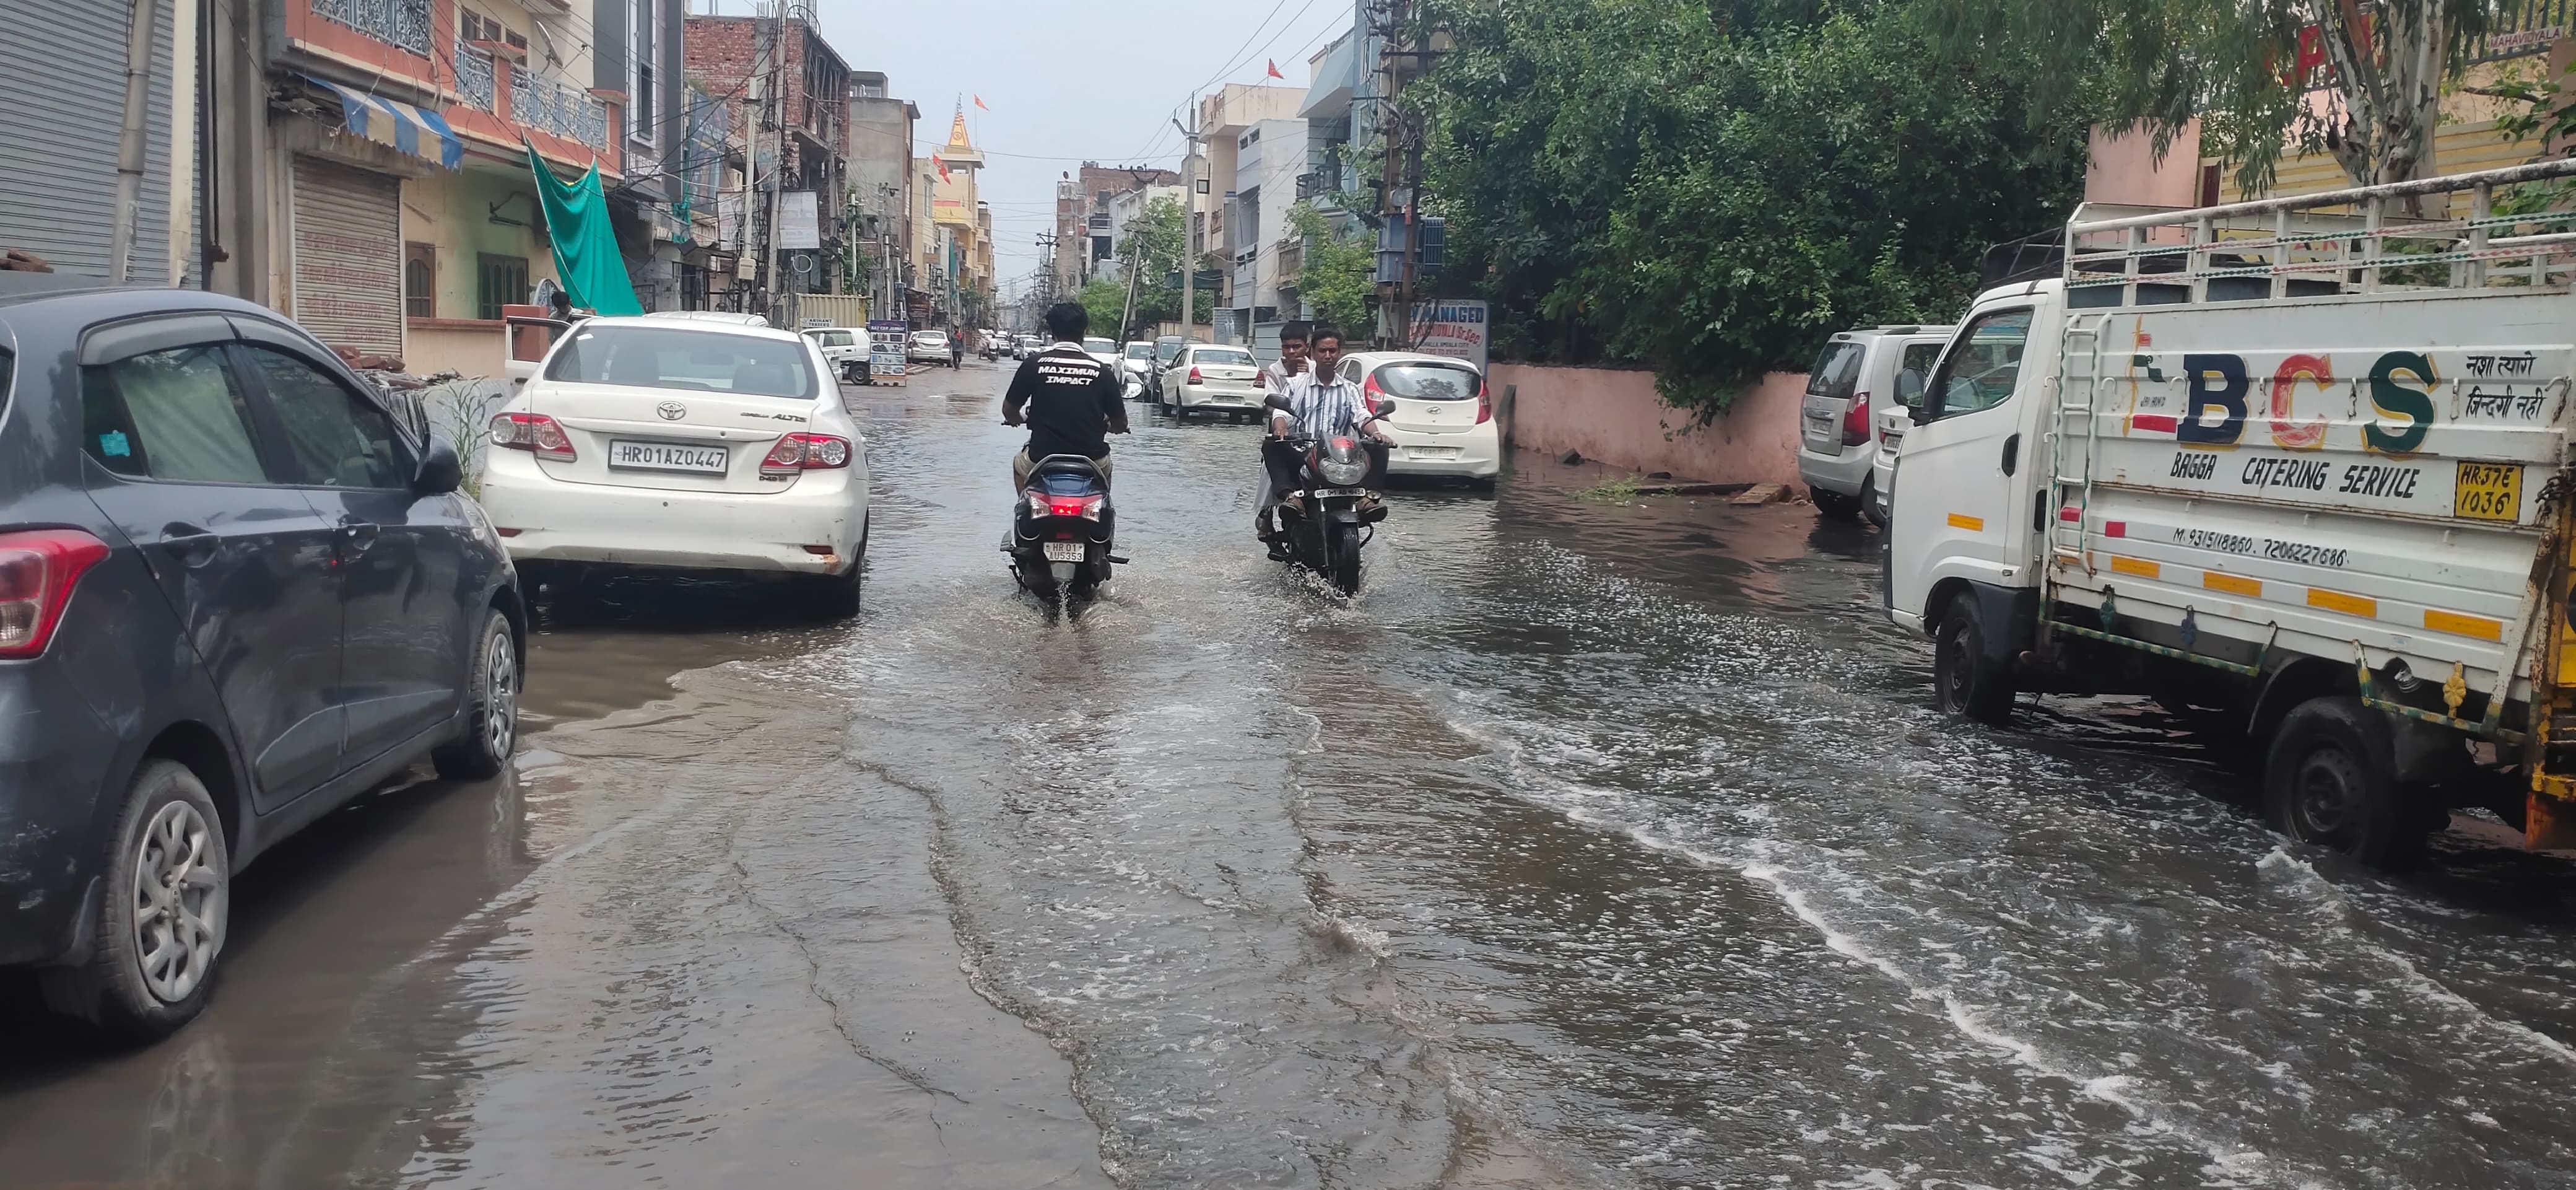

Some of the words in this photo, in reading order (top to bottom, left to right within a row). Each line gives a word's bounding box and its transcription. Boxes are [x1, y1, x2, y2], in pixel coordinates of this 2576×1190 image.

[2491, 27, 2560, 48] MAHAVIDYALA
[1038, 366, 1100, 378] MAXIMUM
[2466, 356, 2495, 378] नशा
[1045, 375, 1093, 385] IMPACT
[772, 414, 807, 423] ALTIS
[622, 445, 725, 468] HR01AZ0447
[2170, 452, 2217, 480] BAGGA
[2242, 457, 2330, 491] CATERING
[2339, 465, 2420, 498] SERVICE
[2461, 491, 2510, 515] 1036
[1053, 543, 1064, 552] HR
[1066, 544, 1076, 552] 01
